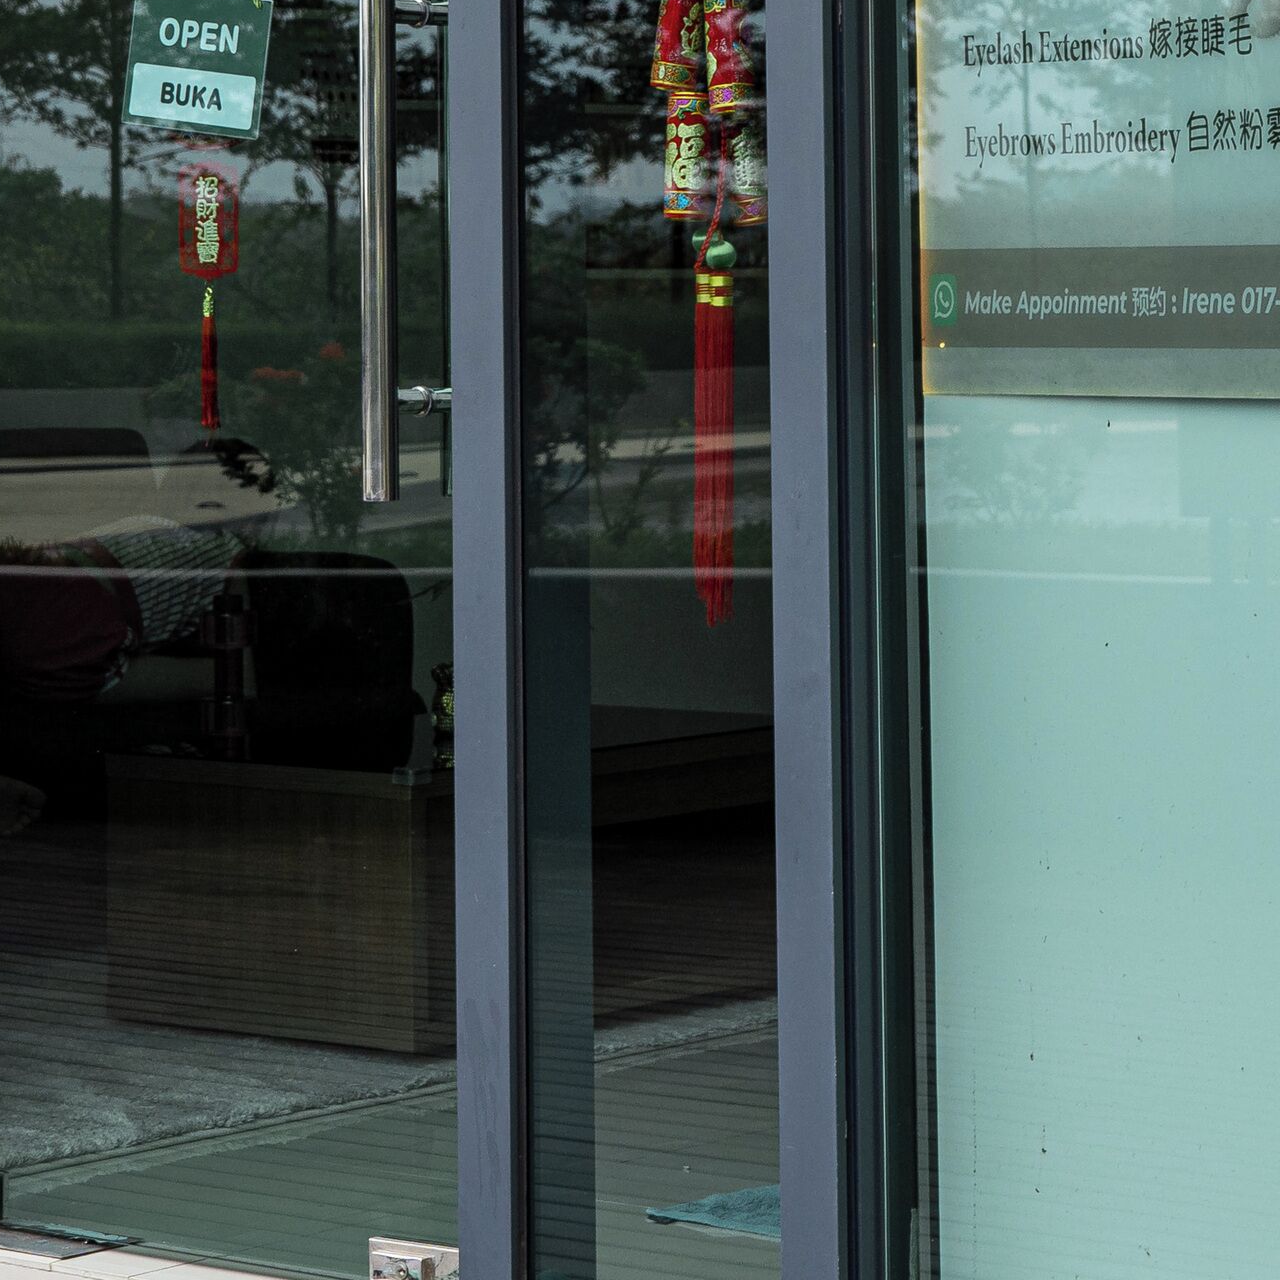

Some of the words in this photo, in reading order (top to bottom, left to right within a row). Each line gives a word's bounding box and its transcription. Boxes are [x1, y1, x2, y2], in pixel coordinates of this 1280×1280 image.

[158, 17, 240, 54] OPEN
[963, 30, 1033, 77] Eyelash
[1038, 27, 1144, 62] Extensions
[1148, 12, 1253, 59] 嫁接睫毛
[160, 82, 222, 111] BUKA
[965, 121, 1056, 170] Eyebrows
[1060, 118, 1182, 164] Embroidery
[965, 288, 1012, 315] Make
[1016, 288, 1127, 320] Appoinment
[1131, 286, 1167, 317] 预约
[1182, 287, 1236, 315] Irene
